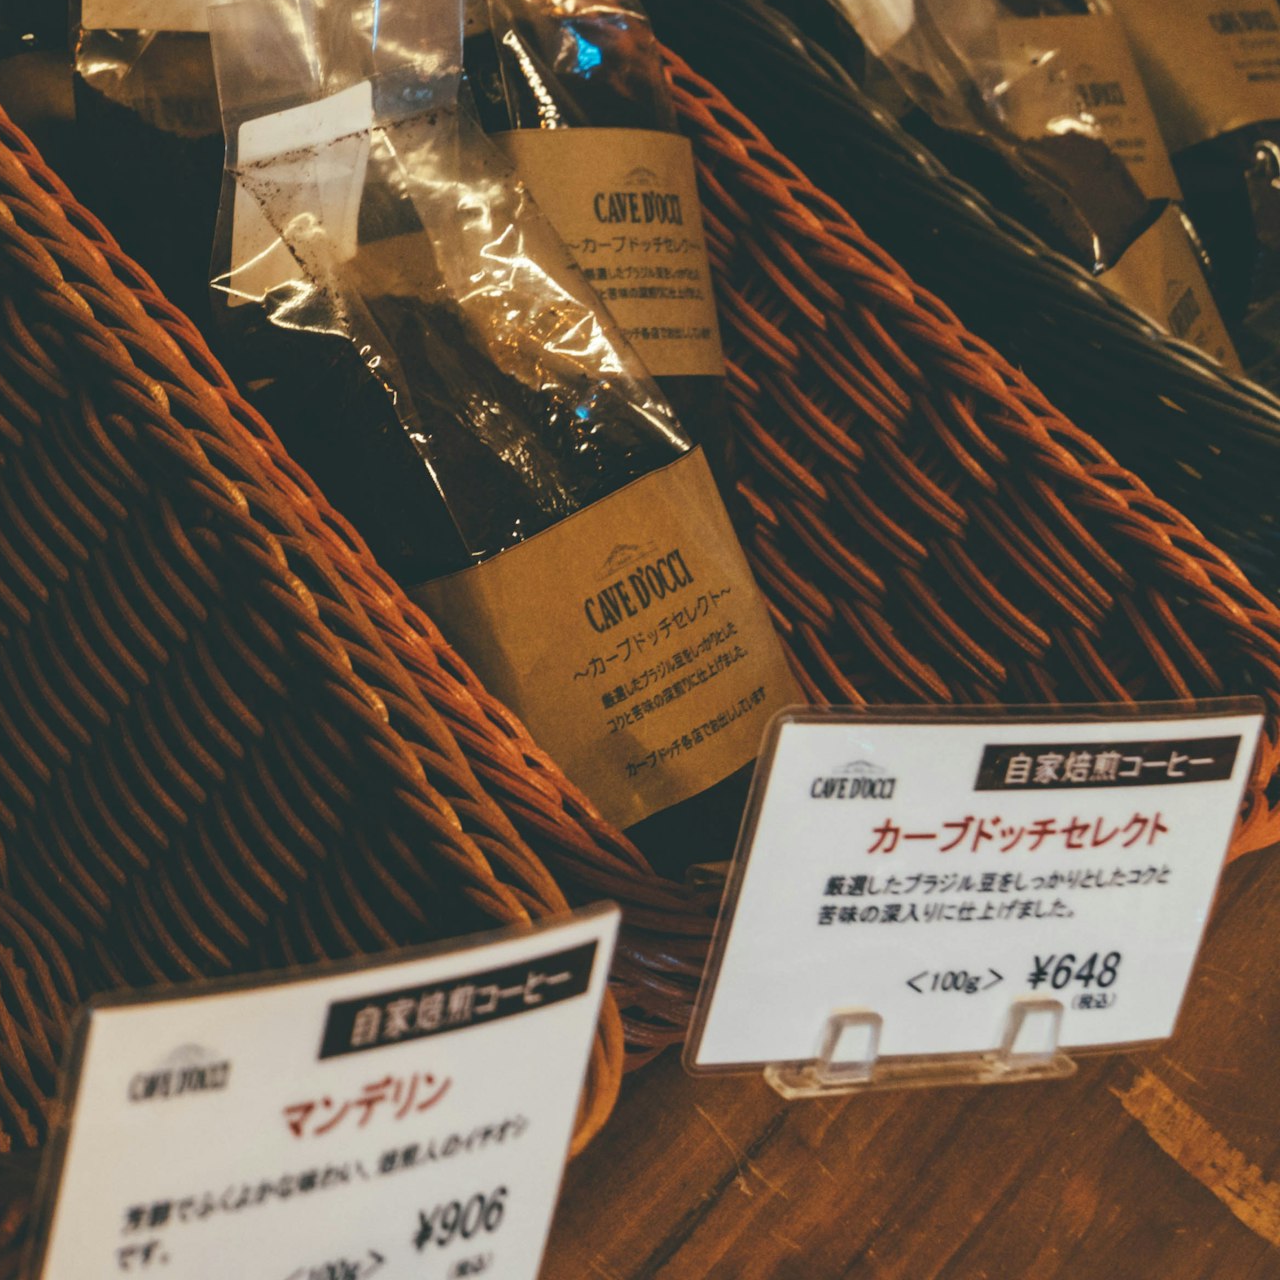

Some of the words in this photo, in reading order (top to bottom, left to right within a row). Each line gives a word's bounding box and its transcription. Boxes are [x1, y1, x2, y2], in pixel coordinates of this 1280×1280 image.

[594, 192, 642, 225] CAVE
[583, 579, 639, 634] CAVE
[810, 777, 851, 800] CAVE
[1003, 750, 1215, 787] 自家焙煎コーヒー
[866, 810, 1170, 855] カーブドッチセレクト
[823, 863, 1173, 897] 厳選したブラジル豆をしっかりとしたコクと
[1026, 951, 1122, 991] ¥648
[348, 969, 574, 1049] 自家焙煎コーヒー
[280, 1071, 453, 1140] マンデリン
[411, 1184, 511, 1253] ¥906
